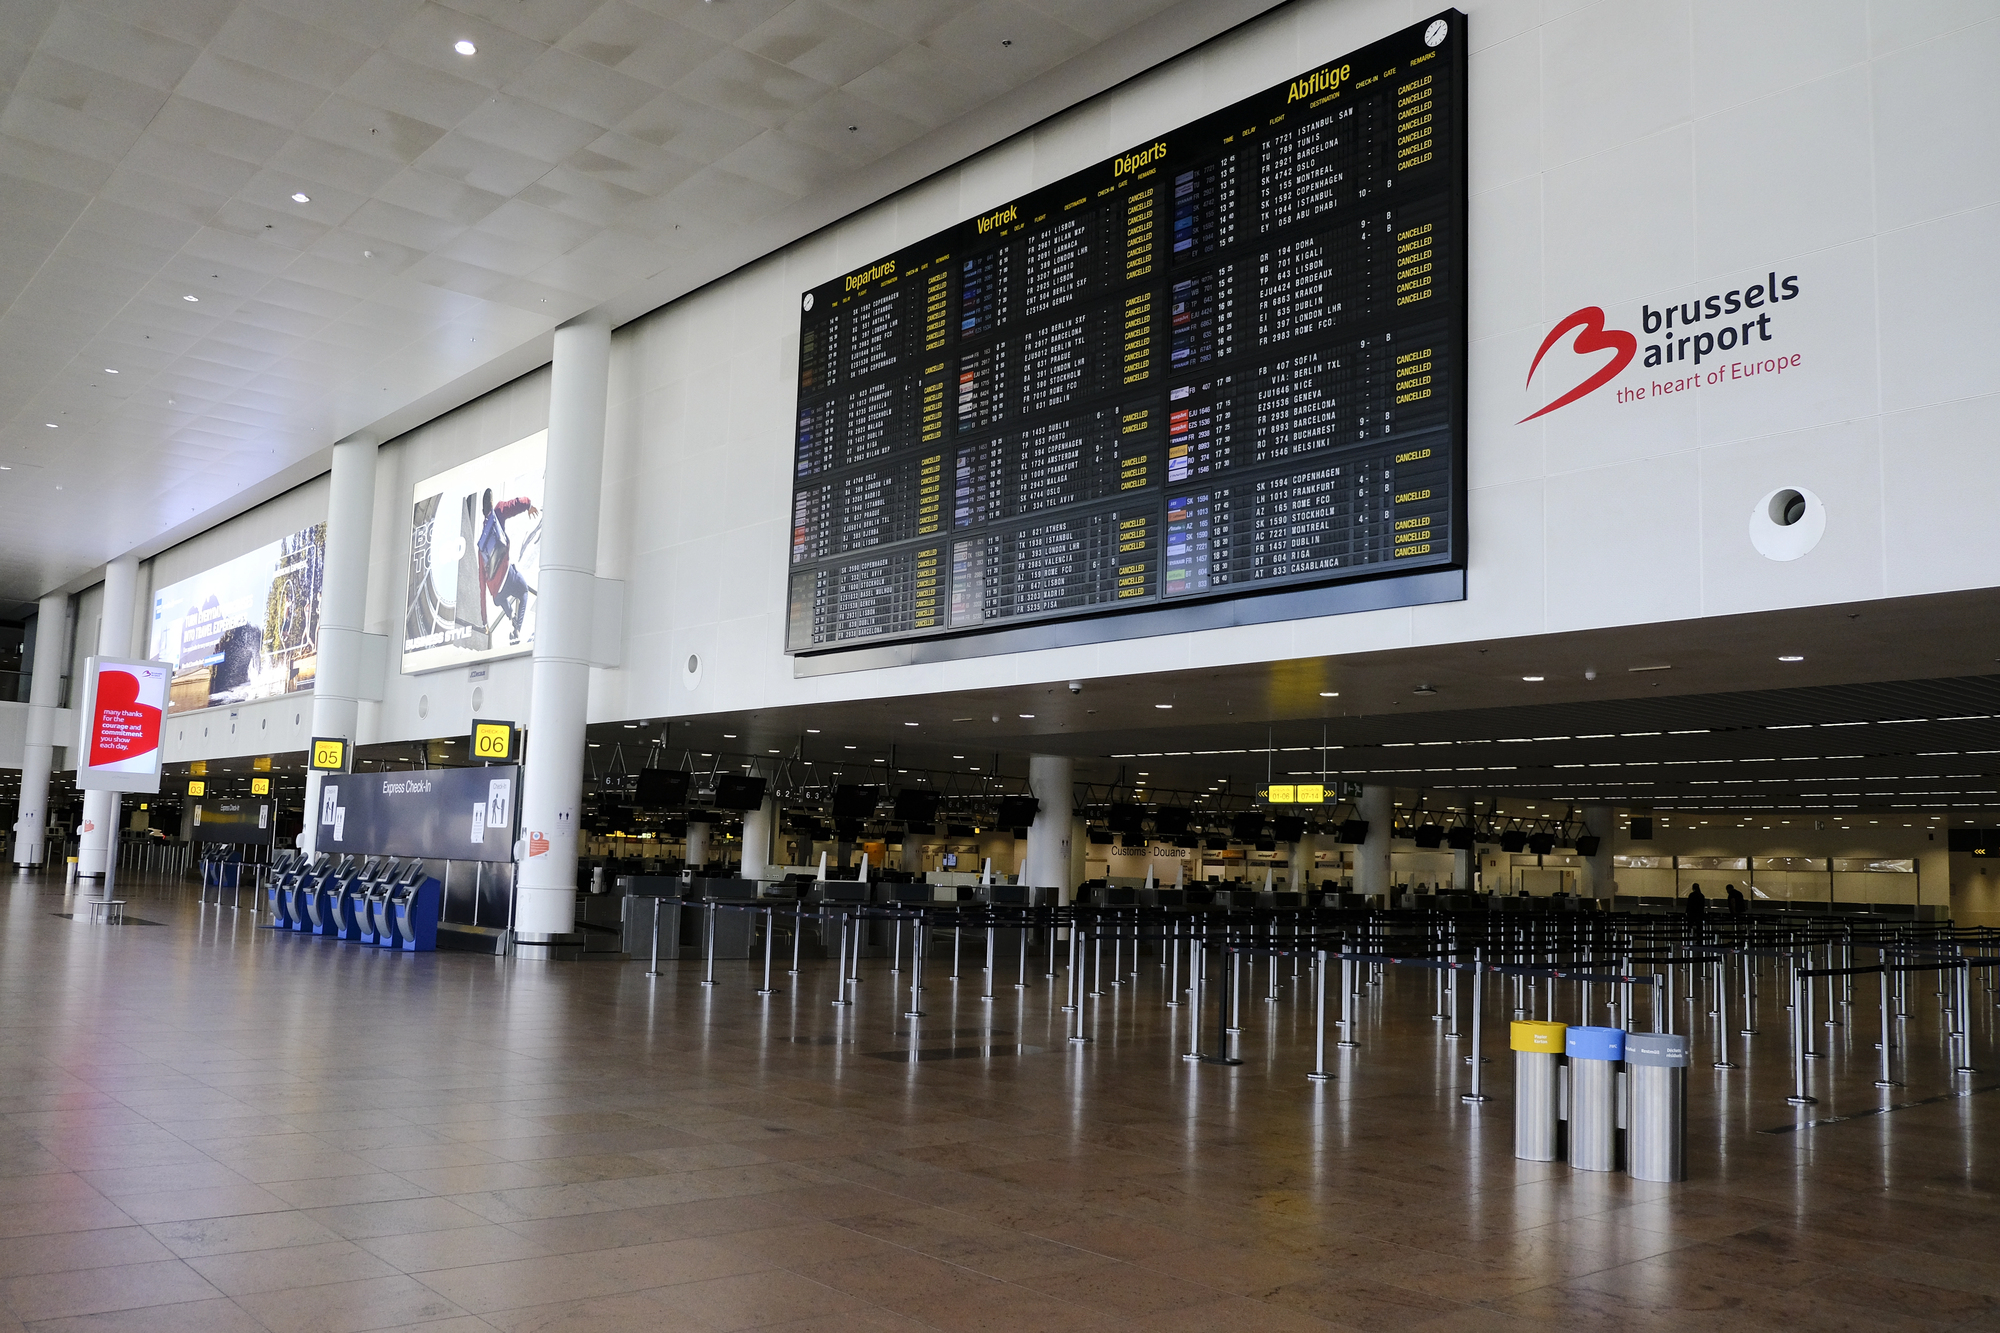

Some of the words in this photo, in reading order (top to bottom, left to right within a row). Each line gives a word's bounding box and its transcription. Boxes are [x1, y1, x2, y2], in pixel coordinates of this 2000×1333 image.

[1223, 134, 1233, 144] TIME
[1242, 125, 1256, 137] DELAY
[1269, 113, 1284, 125] FLIGHT
[1309, 90, 1339, 109] DESTINATION
[1355, 74, 1378, 90] CHECK-IN
[1383, 66, 1396, 78] GATE
[1410, 50, 1435, 67] REMARKS
[1288, 64, 1351, 104] Abflüge
[1261, 140, 1270, 150] TK
[1274, 131, 1292, 145] 7721
[1297, 114, 1334, 136] ISTANBUL
[1338, 107, 1353, 120] SAW
[1397, 74, 1432, 95] CANCELLED
[1261, 163, 1270, 174] FR
[1274, 155, 1291, 169] 2921
[1296, 137, 1338, 161] BARCELONA
[1397, 99, 1432, 121] CANCELLED
[1261, 175, 1270, 186] SK
[1274, 167, 1292, 181] 4742
[1296, 158, 1315, 172] OSLO
[1397, 112, 1432, 133] CANCELLED
[1114, 143, 1167, 178] Départs
[1260, 199, 1270, 209] SK
[1274, 190, 1292, 204] 1592
[1296, 172, 1342, 196] COPENHAGEN
[1397, 138, 1432, 159] CANCELLED
[1261, 187, 1270, 197] TS
[1279, 178, 1292, 191] 155
[1296, 163, 1333, 184] MONTREAL
[1397, 125, 1432, 146] CANCELLED
[1260, 211, 1269, 221] TK
[1274, 203, 1291, 216] 1944
[1296, 188, 1333, 208] ISTANBUL
[1397, 151, 1432, 171] CANCELLED
[977, 204, 1017, 234] Vertrek
[1028, 235, 1035, 244] TP
[1054, 219, 1075, 234] LISBON
[1128, 187, 1153, 204] CANCELLED
[1027, 266, 1034, 275] BA
[1053, 250, 1074, 265] LONDON
[1077, 245, 1088, 256] LHR
[1127, 220, 1152, 237] CANCELLED
[845, 260, 896, 291] Departures
[1259, 281, 1290, 298] EJU4424
[1294, 268, 1332, 287] BORDEAUX
[1396, 235, 1431, 255] CANCELLED
[1259, 300, 1268, 310] FR
[1272, 293, 1290, 306] 6863
[1294, 283, 1322, 299] KRAKOW
[1396, 249, 1431, 268] CANCELLED
[1258, 324, 1267, 334] BA
[1276, 317, 1290, 329] 397
[1294, 308, 1322, 324] LONDON
[1326, 302, 1341, 314] LHR
[1396, 275, 1431, 293] CANCELLED
[1643, 272, 1799, 334] brussels
[1643, 312, 1772, 368] airport
[1257, 384, 1289, 400] EJU1646
[1293, 378, 1312, 391] NICE
[1395, 348, 1431, 365] CANCELLED
[1271, 372, 1288, 384] VIA:
[1293, 364, 1321, 378] BERLIN
[1326, 359, 1340, 370] TXL
[1617, 388, 1646, 404] the
[1652, 372, 1700, 397] heart
[1707, 365, 1726, 385] of
[1732, 353, 1801, 380] Europe
[1257, 414, 1266, 424] FR
[1270, 409, 1288, 421] 2938
[1292, 398, 1335, 416] BARCELONA
[1395, 374, 1431, 391] CANCELLED
[1021, 441, 1028, 450] TP
[1048, 431, 1066, 443] PORTO
[1122, 409, 1148, 423] CANCELLED
[921, 454, 941, 466] CANCELLED
[1256, 482, 1265, 491] SK
[1270, 477, 1287, 488] 1594
[1291, 467, 1339, 484] COPENHAGEN
[1395, 448, 1430, 463] CANCELLED
[1255, 519, 1264, 528] SK
[1269, 515, 1287, 526] 1590
[1291, 506, 1334, 522] STOCKHOLM
[1394, 488, 1430, 503] CANCELLED
[918, 524, 938, 534] CANCELLED
[1018, 541, 1025, 549] TK
[1046, 532, 1073, 544] ISTANBUL
[1119, 517, 1146, 529] CANCELLED
[1254, 569, 1263, 578] AT
[1272, 565, 1286, 575] 833
[1290, 557, 1338, 572] CASABLANCA
[1394, 543, 1430, 557] CANCELLED
[196, 623, 212, 639] TRAVEL
[405, 632, 444, 650] BUSINESS
[445, 626, 472, 642] STYLE
[102, 723, 128, 731] courage
[104, 709, 121, 717] many
[121, 710, 142, 718] thanks
[102, 729, 142, 737] commitment
[116, 743, 128, 751] day.
[480, 736, 504, 752] 06
[318, 750, 338, 765] 05
[190, 786, 202, 794] 03
[254, 784, 266, 792] 04
[382, 781, 405, 797] Express
[405, 779, 432, 793] Check-In
[605, 777, 621, 786] 6.1
[776, 790, 790, 798] 6.2
[806, 791, 820, 799] 6.3
[1272, 792, 1290, 800] 01-06
[1301, 792, 1319, 800] 07-14
[1111, 846, 1146, 856] Customs
[1154, 846, 1186, 857] Douane
